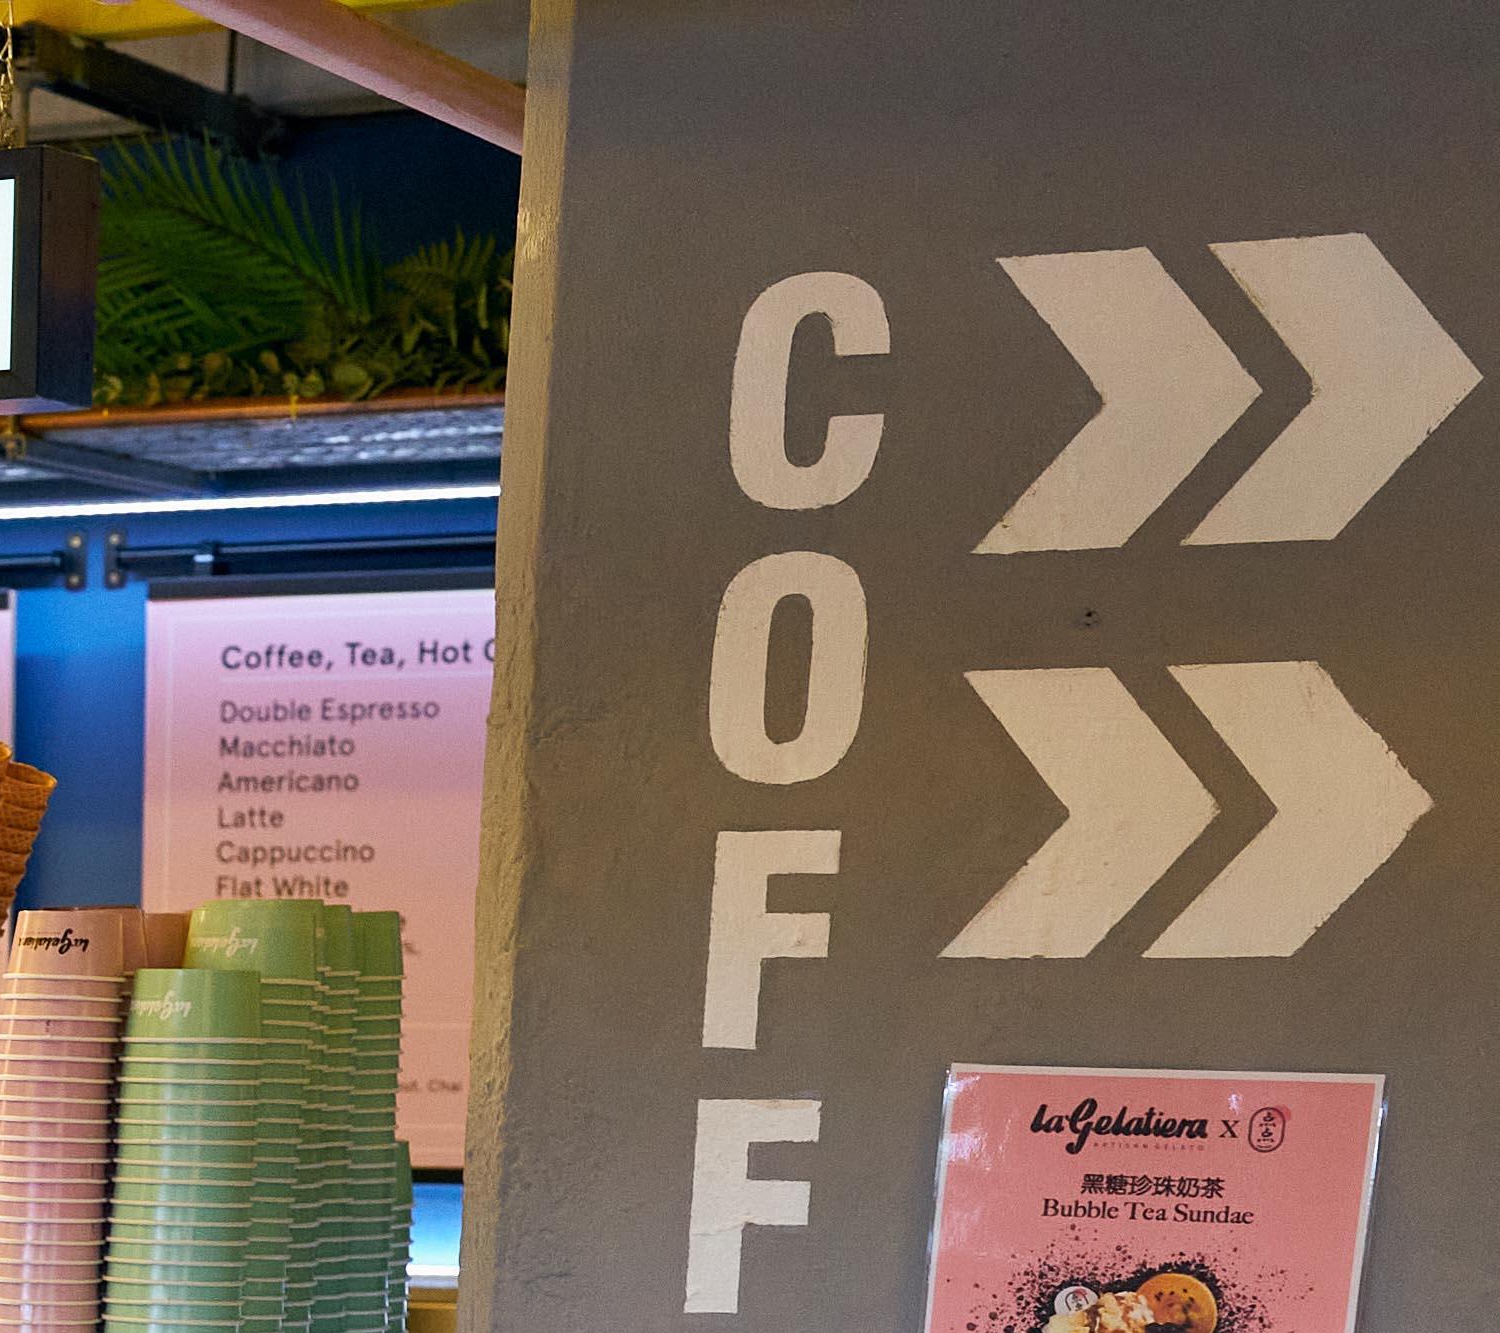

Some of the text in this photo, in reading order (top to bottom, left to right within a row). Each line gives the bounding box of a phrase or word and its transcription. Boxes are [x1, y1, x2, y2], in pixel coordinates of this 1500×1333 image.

[221, 645, 333, 671] Coffee,
[345, 642, 405, 671] Tea,
[419, 640, 472, 665] Hot
[220, 698, 441, 725] Double Espresso
[219, 734, 356, 758] Macchiato
[218, 770, 360, 793] Americano
[217, 807, 284, 829] Latte
[216, 839, 375, 867] Cappuccino
[216, 875, 350, 897] Flat White
[1093, 1141, 1205, 1152] ARTISAN GELATO
[1080, 1173, 1226, 1199] 黑糖珍珠奶茶
[1041, 1198, 1255, 1225] Bubble Tea Sundae
